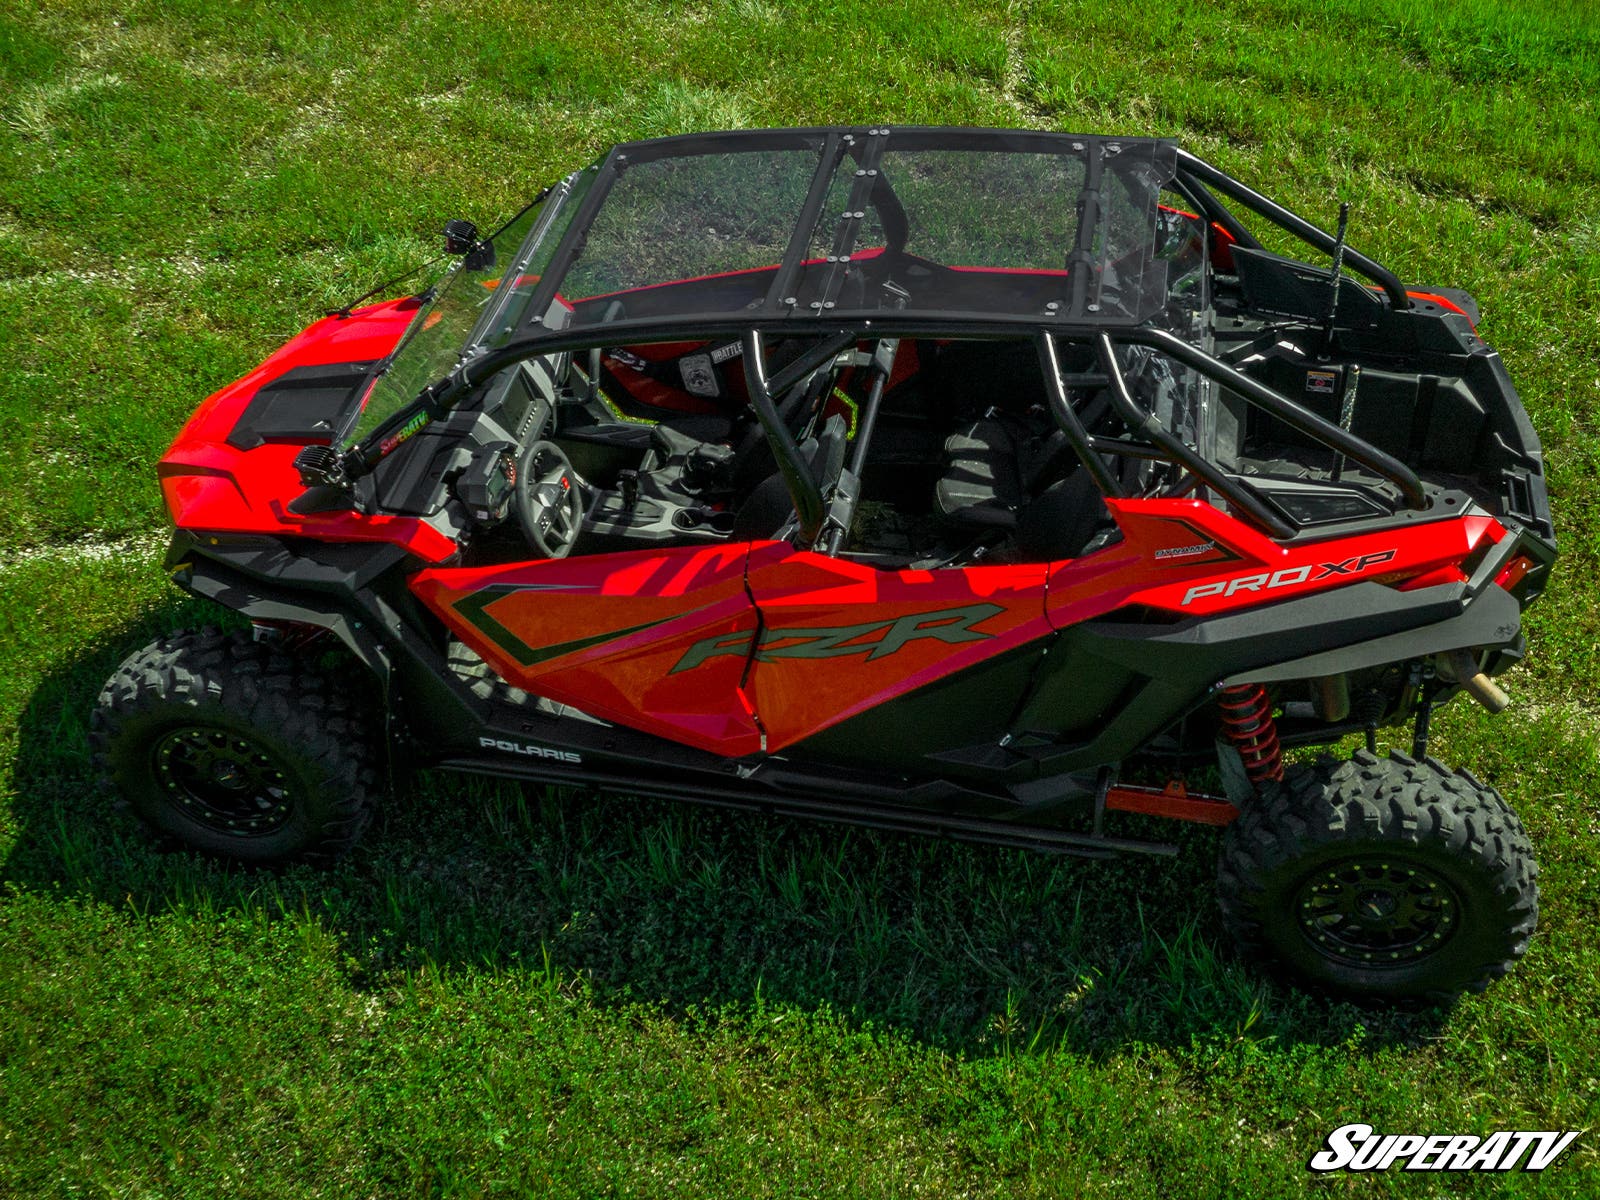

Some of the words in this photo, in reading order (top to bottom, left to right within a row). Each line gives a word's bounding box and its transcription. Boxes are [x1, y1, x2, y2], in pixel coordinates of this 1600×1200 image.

[1181, 565, 1312, 606] PRO
[1310, 549, 1398, 581] XP
[668, 603, 1008, 675] RZR
[480, 737, 581, 763] POLARIS
